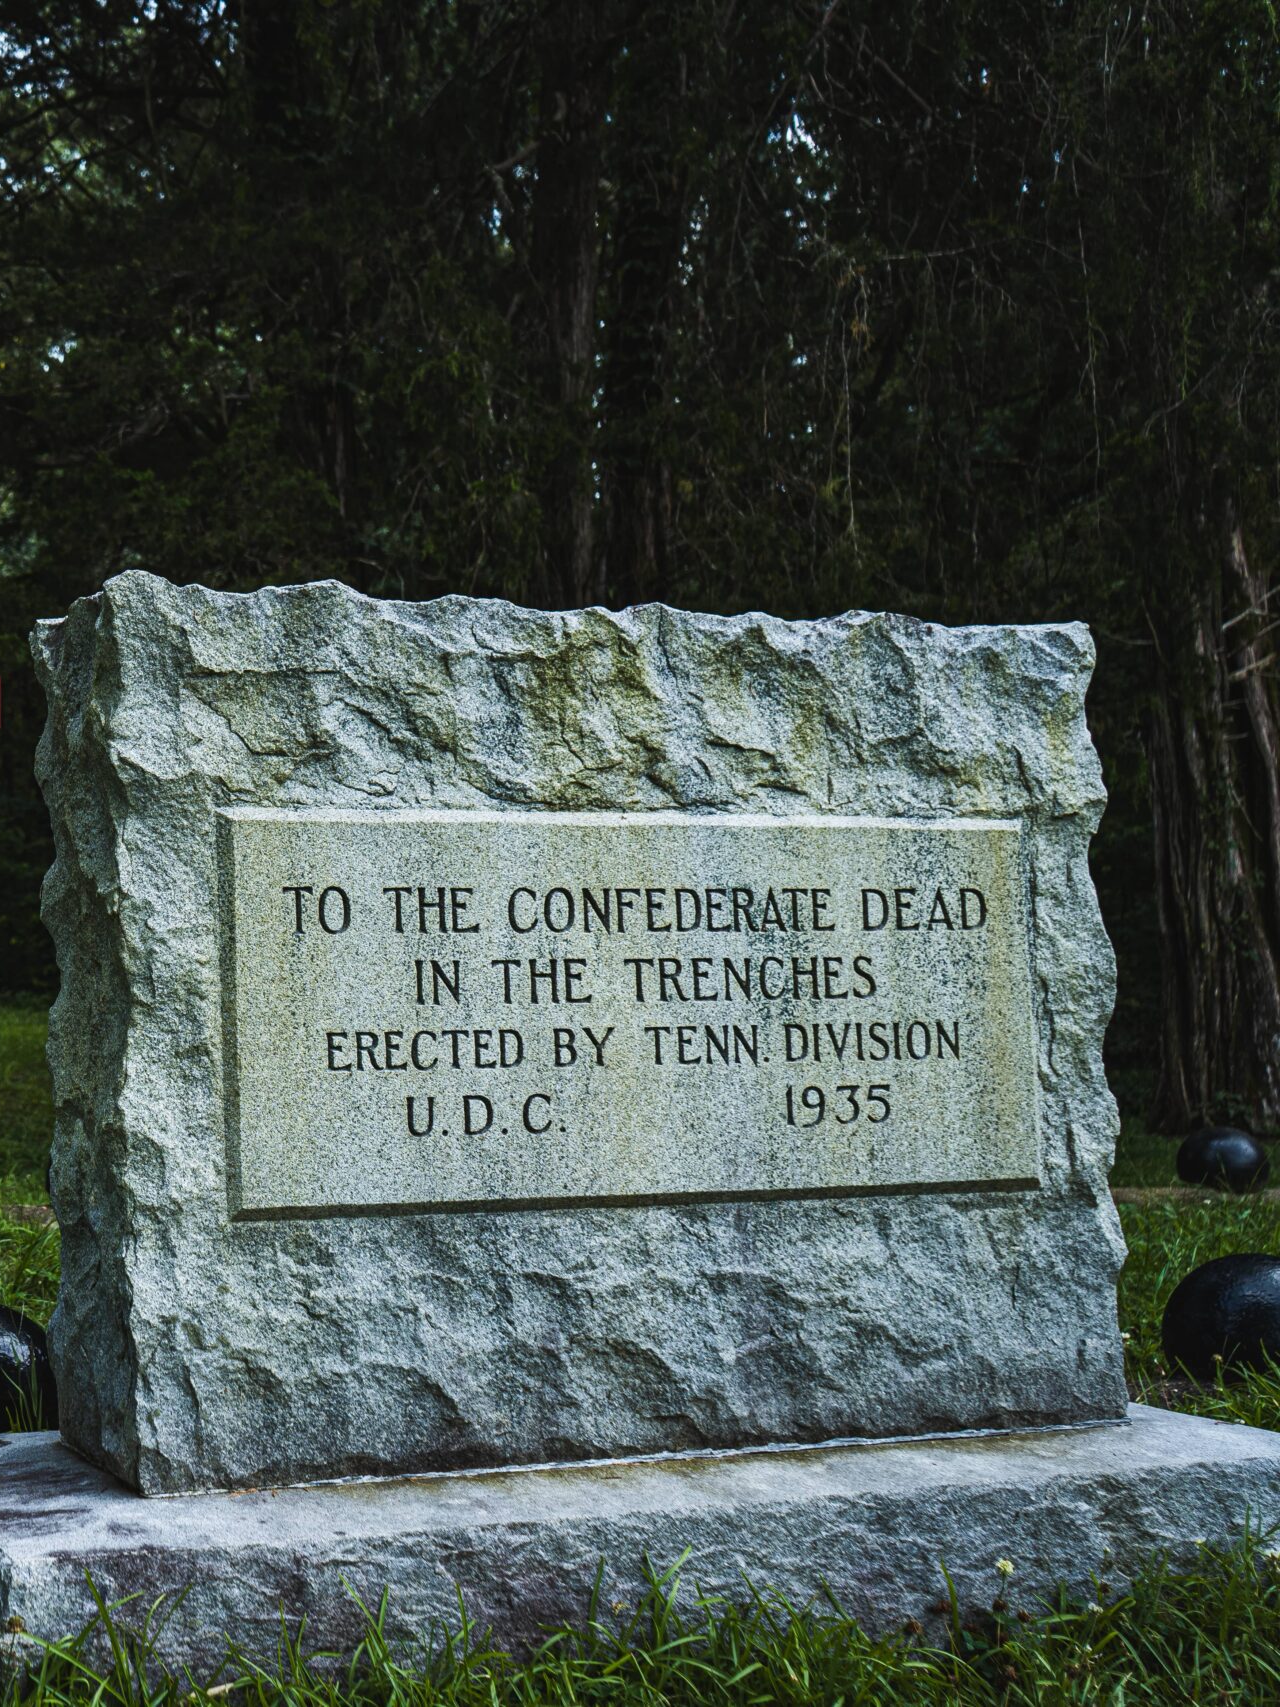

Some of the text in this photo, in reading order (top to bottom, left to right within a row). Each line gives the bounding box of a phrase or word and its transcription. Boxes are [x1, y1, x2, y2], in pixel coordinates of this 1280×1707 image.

[282, 885, 989, 936] TO THE CONFEDERATE DEAD
[414, 956, 878, 1006] IN THE TRENCHES
[325, 1021, 962, 1071] ERECTED BY TENN. DIVISION
[784, 1084, 892, 1128] 1935
